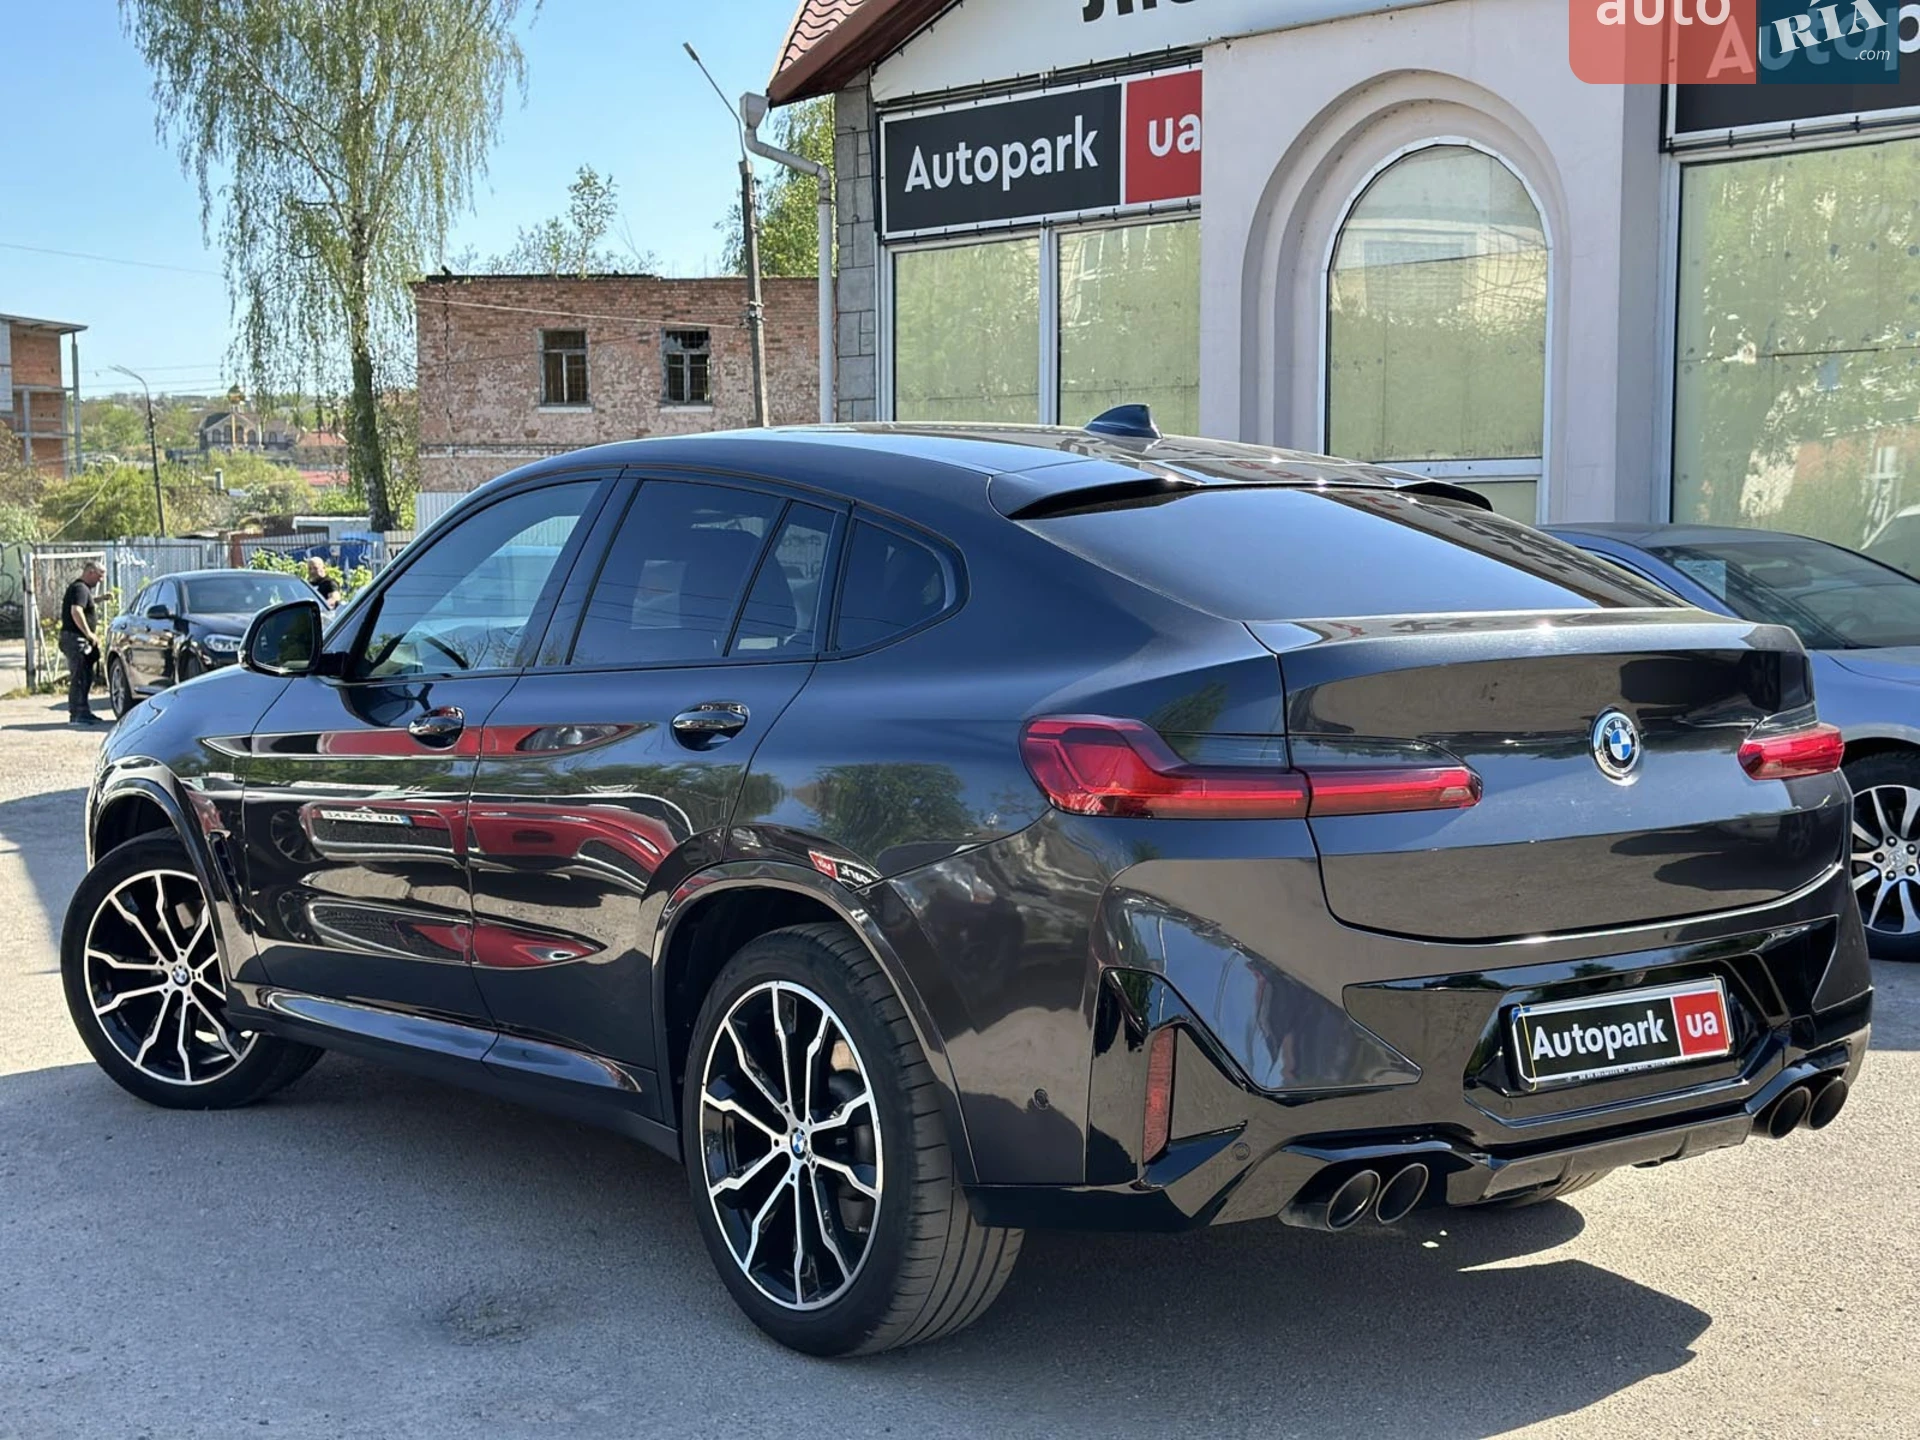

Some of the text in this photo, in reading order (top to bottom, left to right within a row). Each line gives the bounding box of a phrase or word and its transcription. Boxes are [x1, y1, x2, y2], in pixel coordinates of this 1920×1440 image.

[904, 113, 1201, 192] Autopark ua
[1532, 1010, 1719, 1060] Autopark ua
